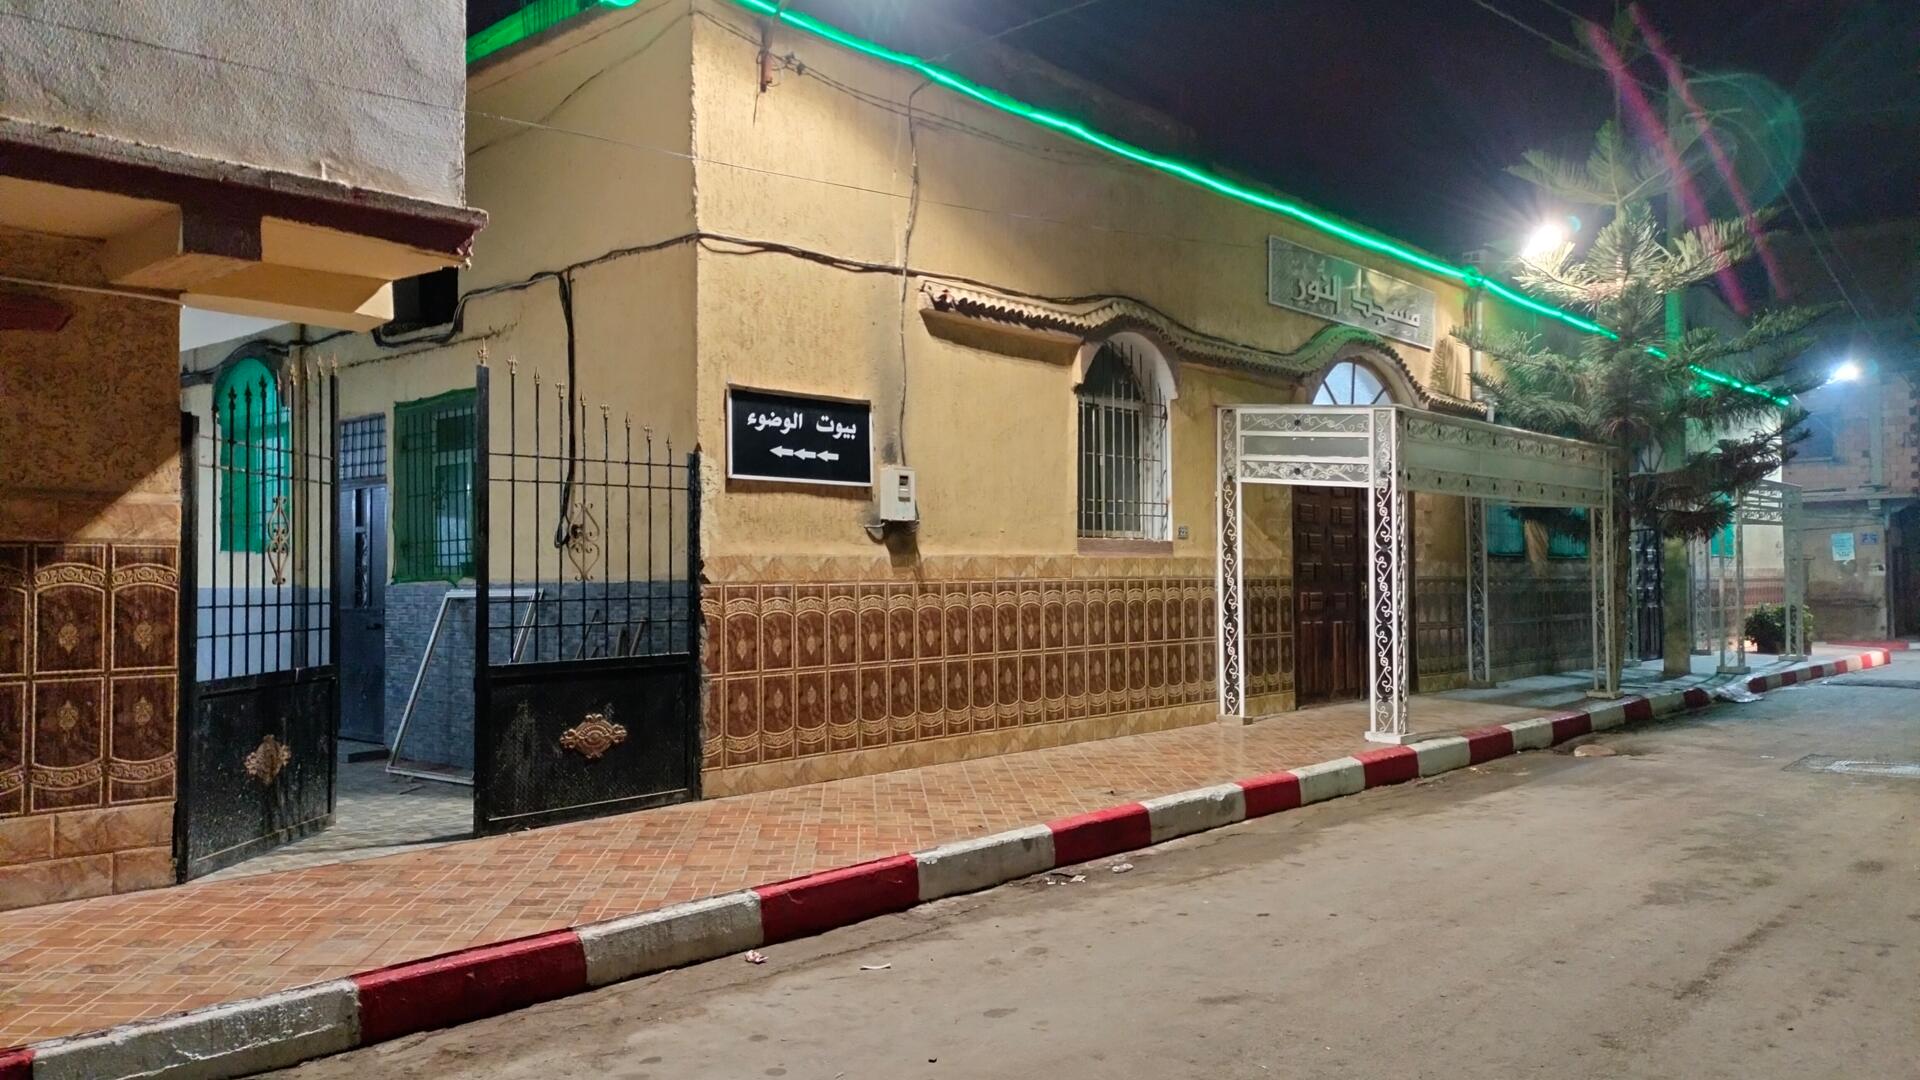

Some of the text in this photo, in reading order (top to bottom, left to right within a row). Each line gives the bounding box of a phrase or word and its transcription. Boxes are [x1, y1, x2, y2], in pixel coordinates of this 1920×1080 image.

[1290, 268, 1420, 327] مسجد النور
[747, 411, 857, 439] بيوت الوضوء
